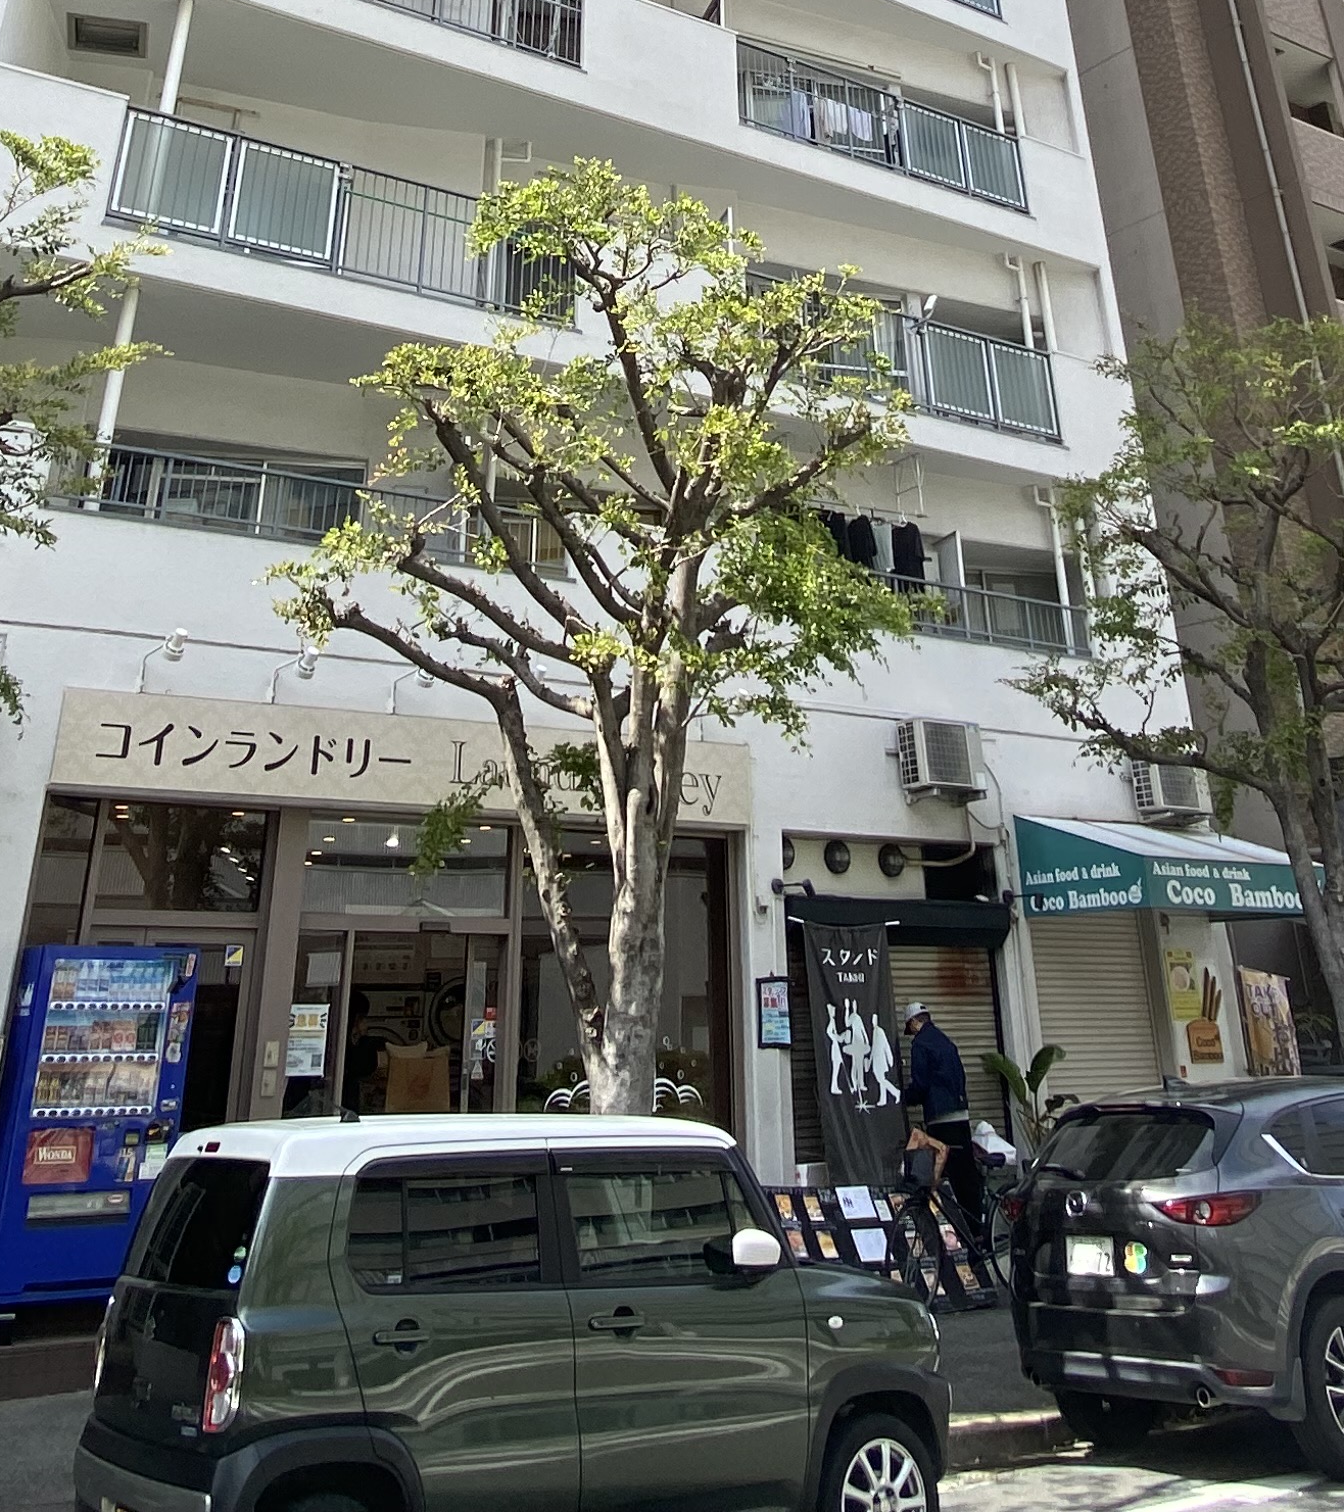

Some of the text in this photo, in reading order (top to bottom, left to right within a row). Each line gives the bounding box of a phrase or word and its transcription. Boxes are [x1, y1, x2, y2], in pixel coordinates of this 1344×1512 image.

[96, 723, 412, 778] コインランドリー
[1026, 870, 1055, 886] Asian
[1055, 866, 1079, 883] food
[1090, 862, 1121, 879] drink
[1152, 861, 1188, 877] Asian
[1186, 864, 1210, 879] food
[1222, 867, 1251, 881] drink
[1067, 888, 1128, 910] Bamboo
[1166, 879, 1216, 906] Coco
[38, 1146, 73, 1163] WONDA
